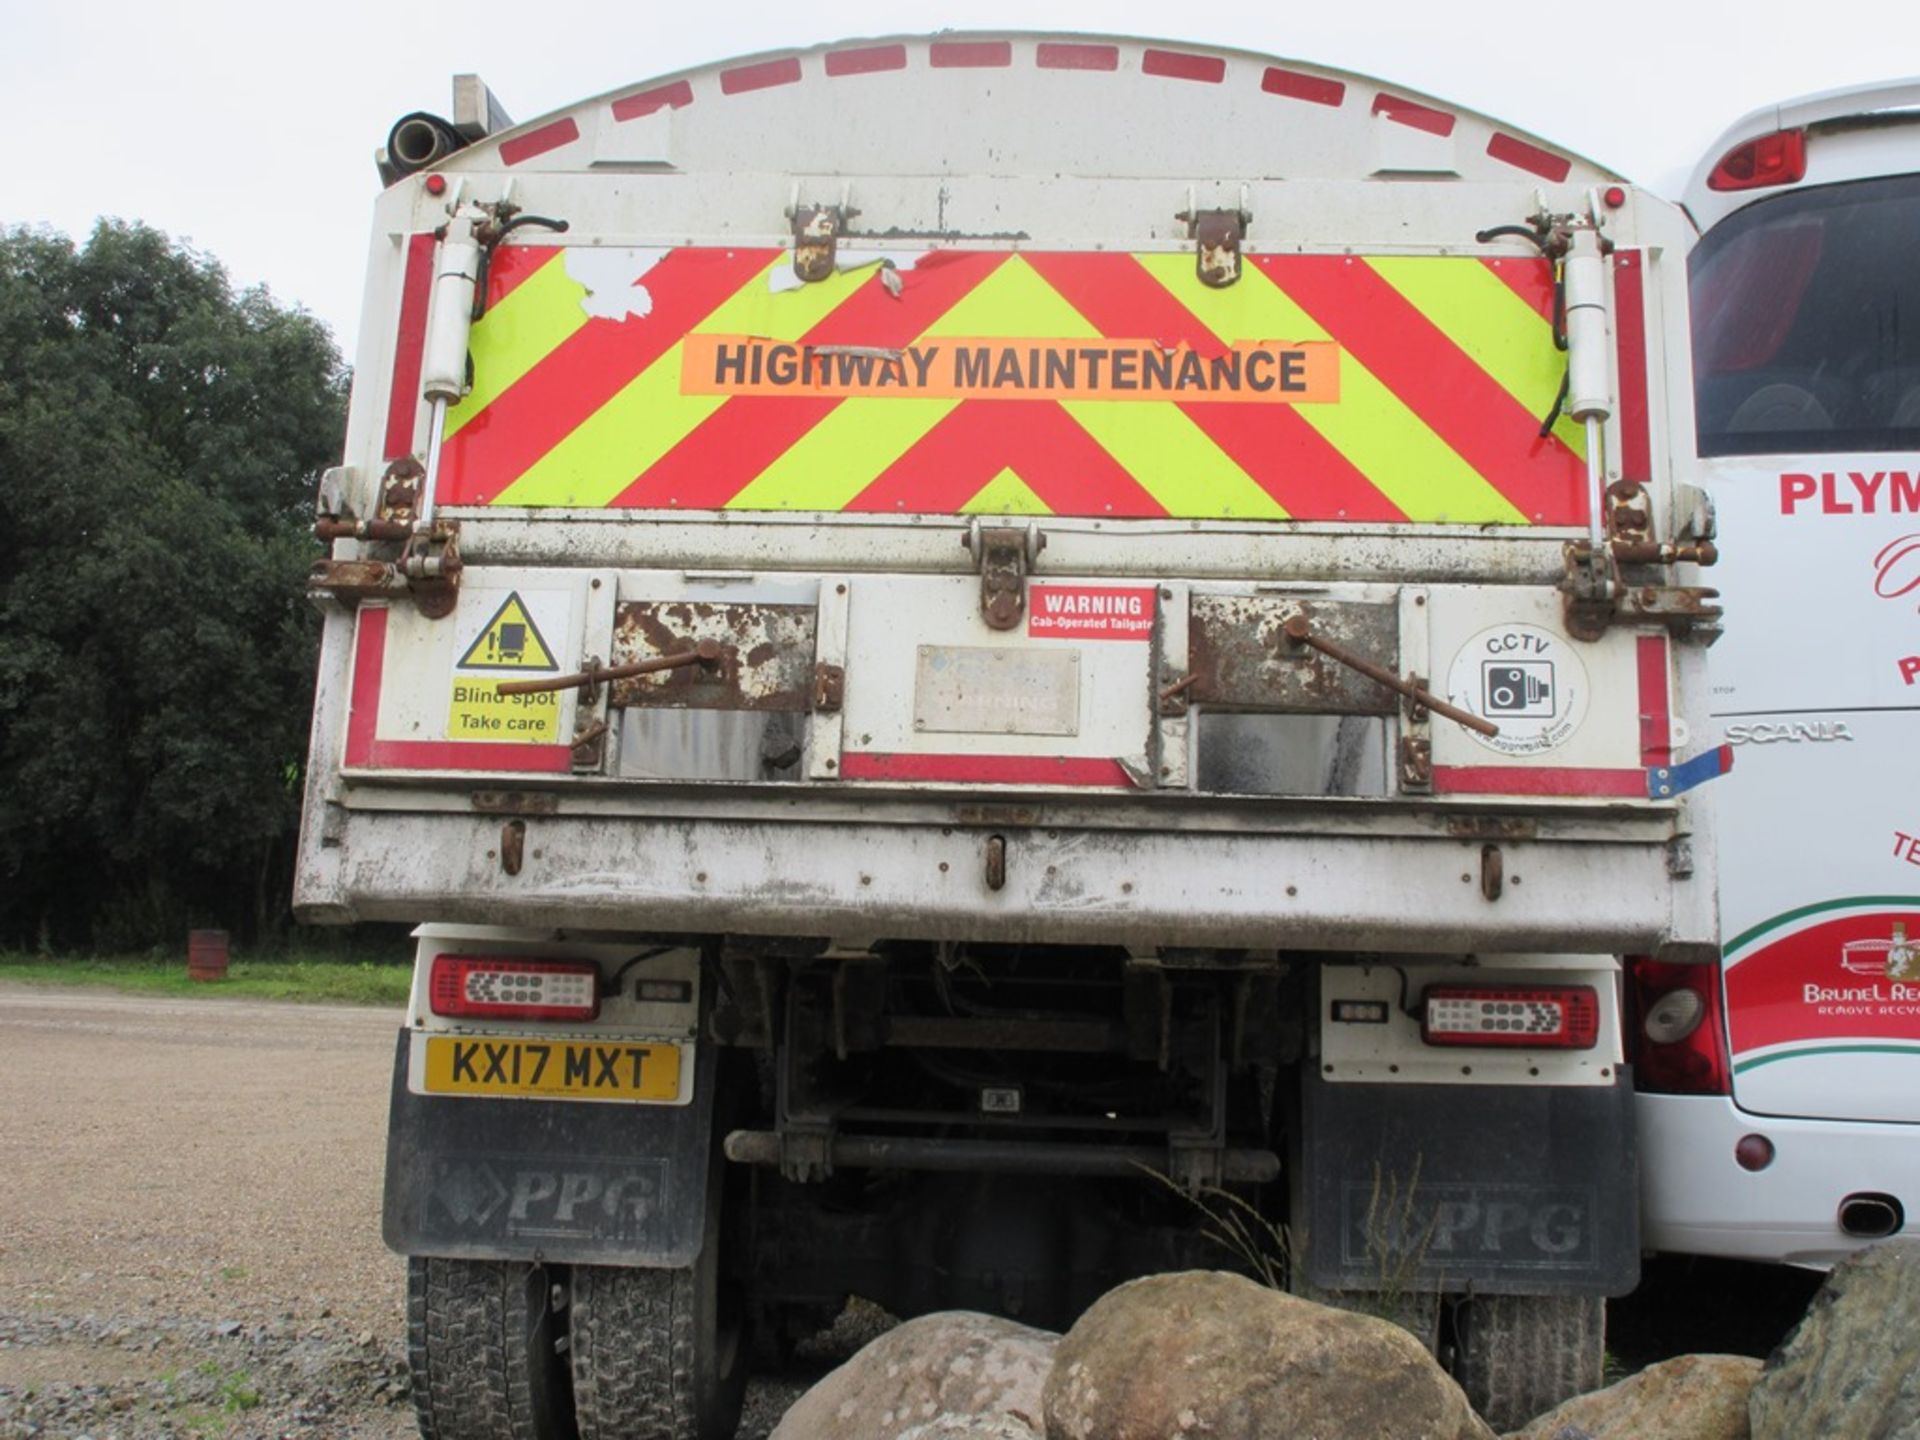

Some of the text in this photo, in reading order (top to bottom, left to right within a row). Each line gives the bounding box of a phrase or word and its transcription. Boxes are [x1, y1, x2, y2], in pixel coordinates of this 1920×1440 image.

[714, 344, 1307, 392] HIGHWAY MAINTENANCE
[1780, 471, 1920, 515] PLYM
[1044, 595, 1142, 615] WARNING
[1031, 615, 1107, 630] Cab-Operated
[1486, 633, 1550, 654] CCTV
[453, 687, 556, 708] Blind spot
[460, 714, 546, 731] Take care
[1725, 720, 1854, 746] SCANIA
[1891, 982, 1920, 1001] RE
[1818, 1006, 1873, 1015] REMOVE
[452, 1043, 650, 1089] KX17 MXT
[508, 1171, 654, 1223] PPG
[1431, 1201, 1580, 1254] PPG
